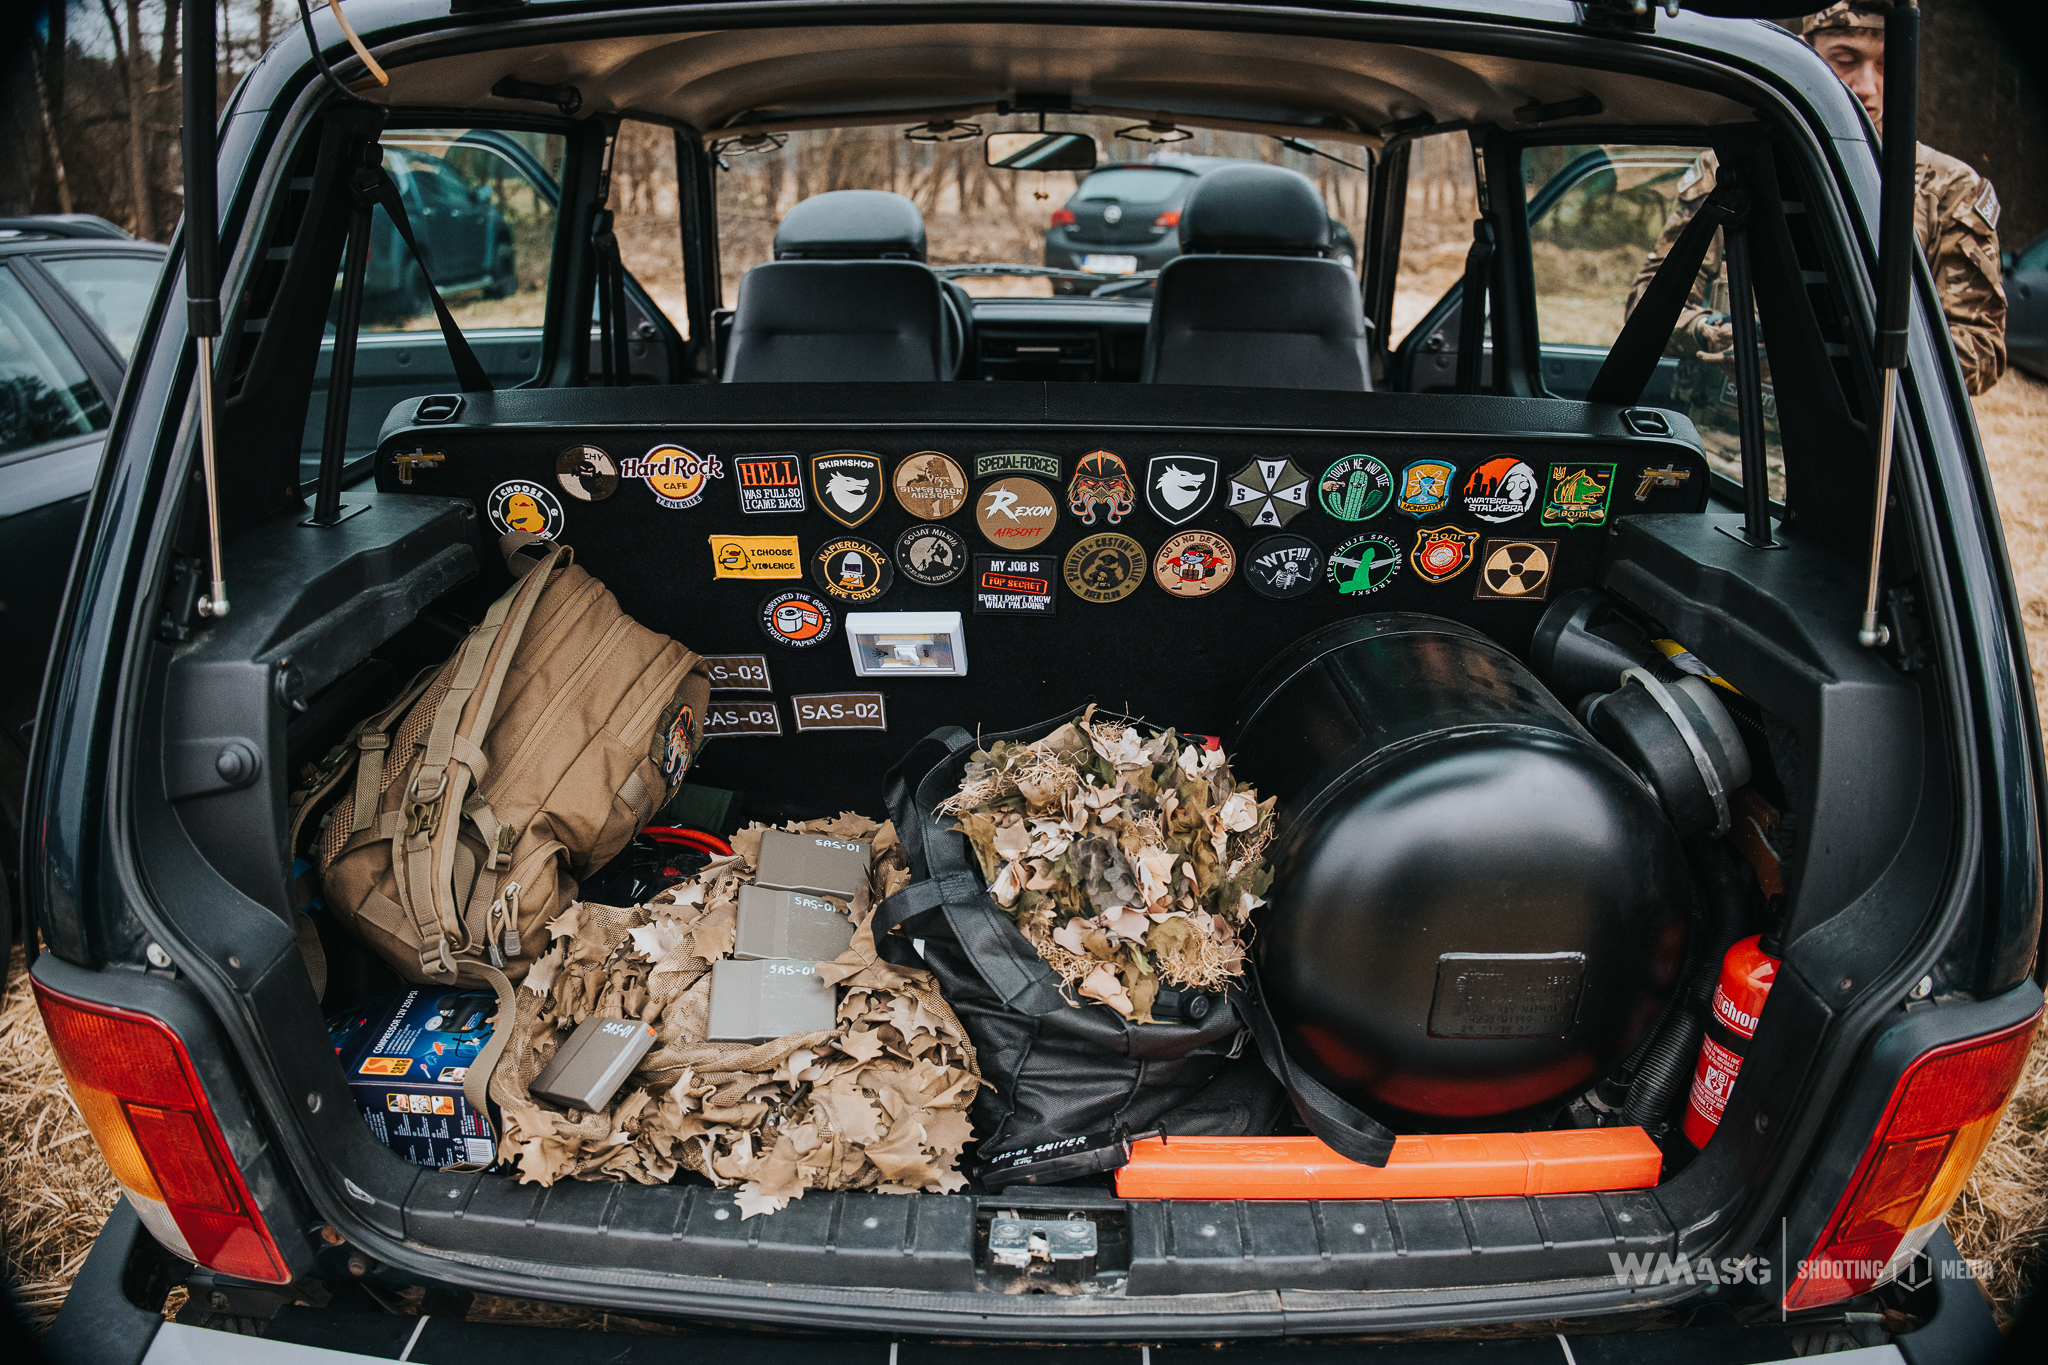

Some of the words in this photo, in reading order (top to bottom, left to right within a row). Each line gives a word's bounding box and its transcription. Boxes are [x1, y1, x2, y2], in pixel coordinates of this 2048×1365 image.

[621, 455, 671, 477] Hard
[673, 454, 723, 480] Rock
[818, 459, 874, 470] SKIRMSHOP
[979, 455, 1057, 474] SPECIAL-FORCES
[739, 461, 798, 486] HELL
[1327, 460, 1351, 480] TOUCH
[1353, 458, 1365, 470] ME
[1364, 460, 1381, 475] AND
[1375, 473, 1390, 488] DIE
[500, 484, 544, 499] CHOOSE
[663, 482, 688, 490] CAFE
[743, 489, 762, 499] WAS
[763, 488, 787, 499] FULL
[788, 487, 800, 498] SO
[900, 486, 963, 495] SILVERBACK
[657, 495, 702, 508] TENERIFE
[745, 500, 751, 509] I
[751, 498, 777, 509] CAME
[778, 497, 802, 508] BACK
[1463, 496, 1508, 505] KWATERA
[1468, 503, 1525, 513] STALKERA
[1560, 510, 1589, 518] ВОЛЯ
[994, 527, 1043, 538] AIRSOFT
[751, 549, 756, 557] I
[1161, 547, 1173, 559] DO
[1173, 540, 1181, 548] U
[1181, 535, 1195, 544] NO
[1199, 535, 1212, 543] DE
[1212, 540, 1231, 559] WAE?
[1067, 545, 1090, 582] SPRINTER
[1095, 537, 1132, 552] CUSTOM
[1128, 552, 1144, 583] GHILLIE
[1255, 547, 1311, 568] WTF!!!
[751, 562, 796, 570] VIOLENCE
[990, 560, 1006, 572] MY
[1007, 561, 1027, 572] JOB
[1029, 562, 1040, 573] IS
[1333, 535, 1365, 557] CHUJE
[1352, 579, 1392, 596] TROSKI
[988, 576, 1006, 587] TOP
[1007, 579, 1042, 592] SECRET
[851, 586, 881, 601] CHUJE
[978, 594, 998, 603] EVEN
[1028, 595, 1052, 604] KNOW
[1083, 588, 1102, 600] USER
[1103, 590, 1121, 600] CLUB
[764, 593, 794, 615] SURVIVED
[795, 593, 811, 601] THE
[812, 599, 831, 617] GREAT
[985, 600, 1006, 609] WHAT
[1021, 602, 1045, 610] DOING
[767, 626, 790, 644] TOILET
[791, 638, 817, 647] PAPER
[815, 623, 832, 641] CRISIS
[708, 665, 764, 680] S-03
[801, 703, 879, 720] SAS-02
[814, 838, 860, 853] SAS-01
[401, 999, 414, 1009] 250
[395, 1008, 408, 1019] 12V
[372, 1019, 402, 1054] COMPRESSOR
[602, 1022, 636, 1038] SAS-01
[991, 1148, 1028, 1164] SAS-01
